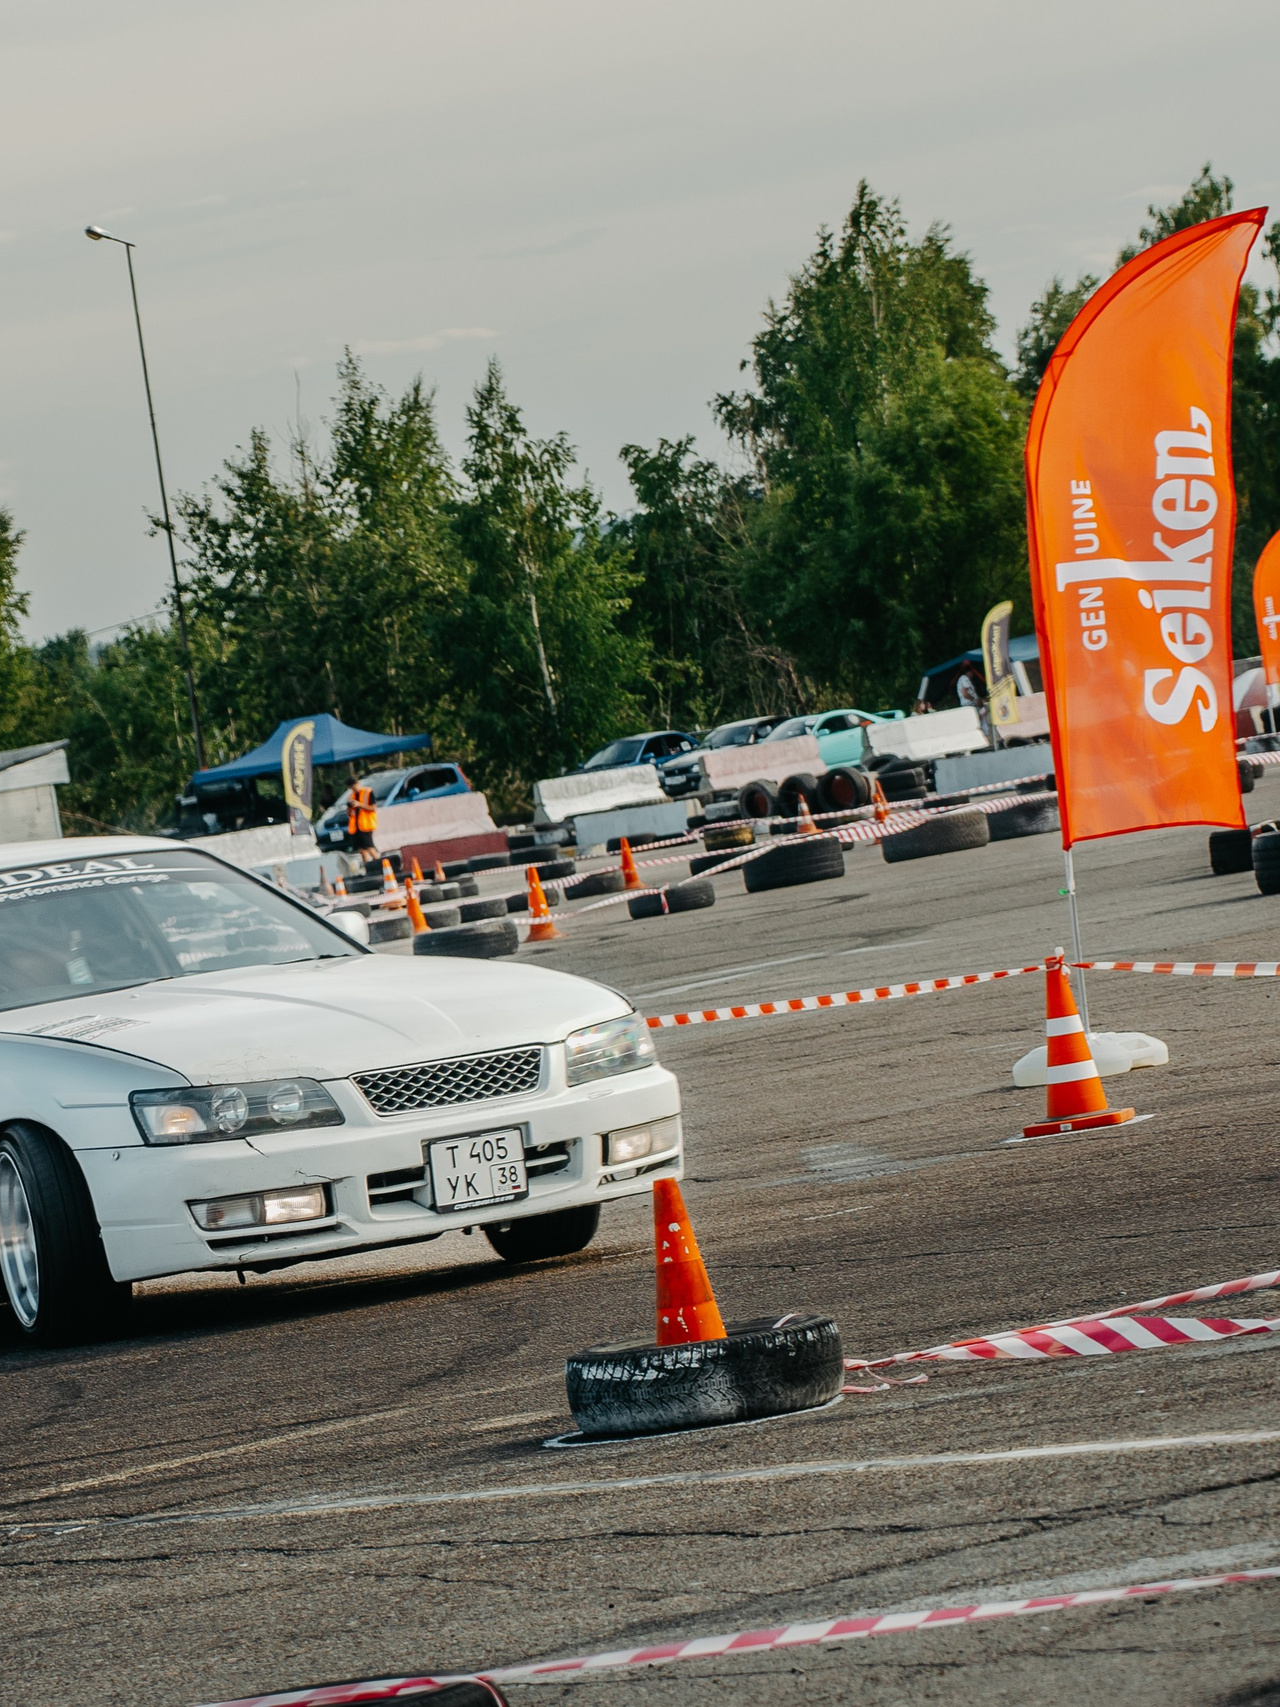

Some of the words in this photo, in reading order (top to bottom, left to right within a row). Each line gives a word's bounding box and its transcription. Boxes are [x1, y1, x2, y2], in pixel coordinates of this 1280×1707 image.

[1056, 406, 1218, 732] Seiken
[104, 872, 170, 885] Garage
[446, 1145, 459, 1168] Т
[470, 1137, 508, 1164] 405
[447, 1172, 480, 1200] УК
[498, 1165, 519, 1185] 38
